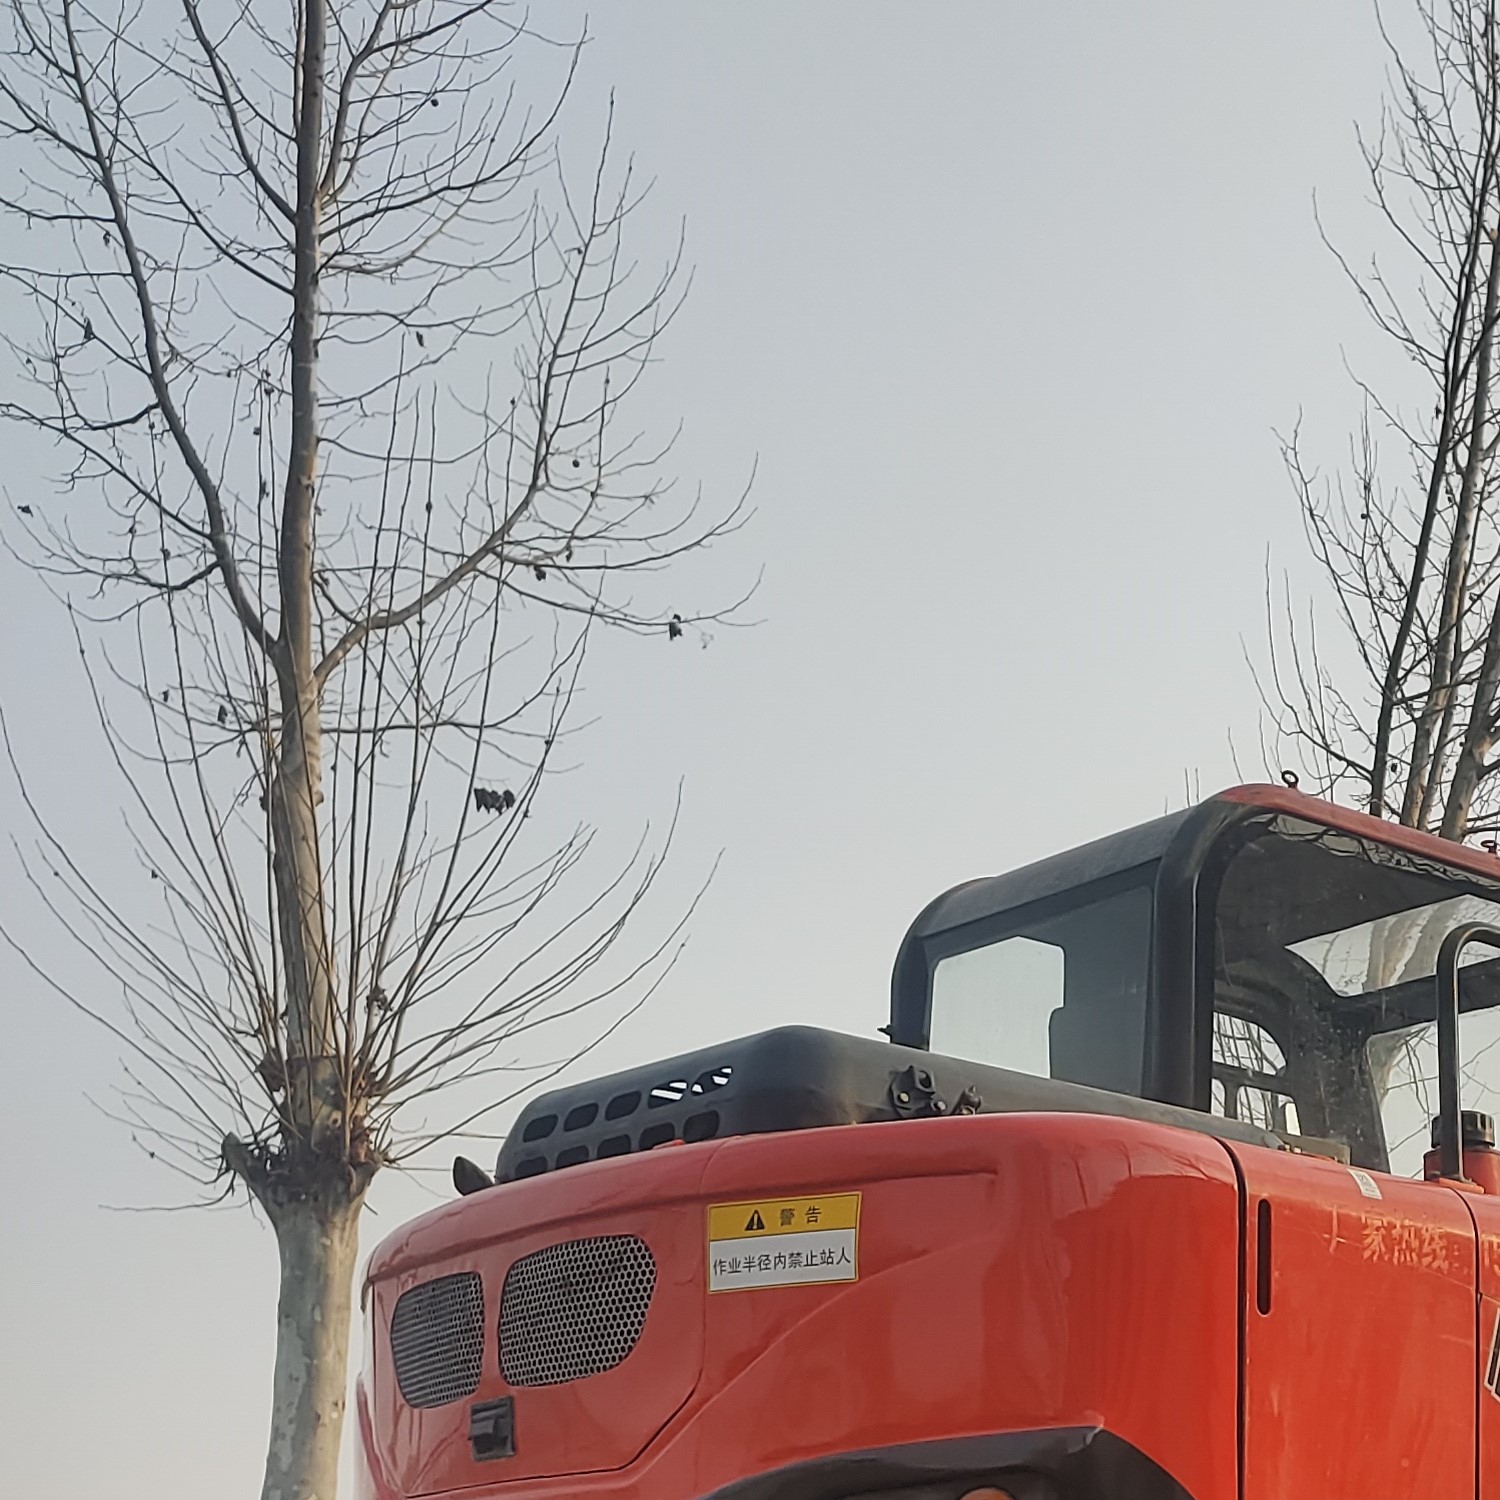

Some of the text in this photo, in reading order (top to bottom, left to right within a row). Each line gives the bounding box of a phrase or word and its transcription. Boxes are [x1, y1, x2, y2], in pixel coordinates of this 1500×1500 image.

[779, 1206, 822, 1227] 警告
[713, 1246, 851, 1276] 作业半径内禁止站人
